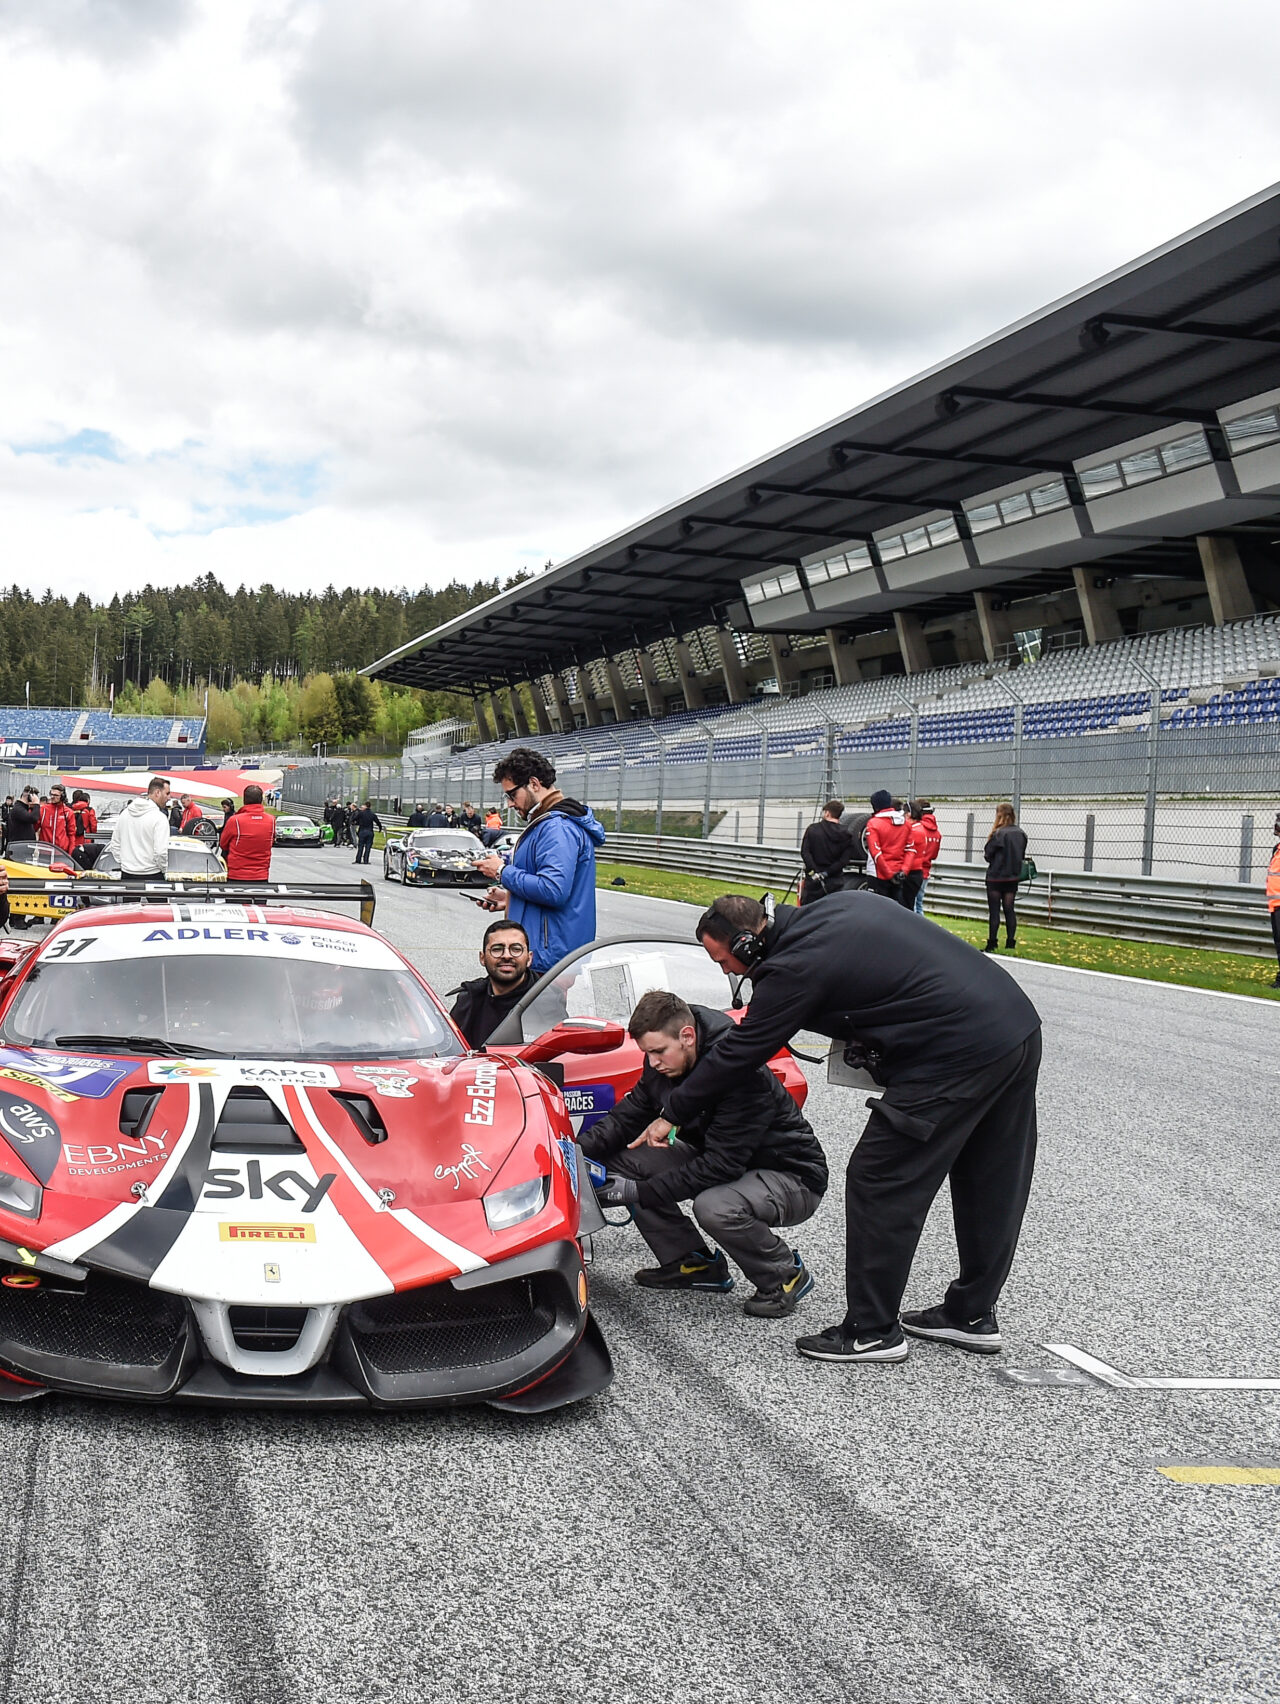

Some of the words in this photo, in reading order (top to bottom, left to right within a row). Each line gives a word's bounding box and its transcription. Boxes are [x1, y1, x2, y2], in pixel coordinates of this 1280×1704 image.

[53, 895, 74, 907] 26
[142, 928, 270, 942] ADLER
[45, 938, 99, 960] 37
[239, 1068, 327, 1079] KAPCI
[245, 1076, 327, 1085] COATINGS
[463, 1098, 496, 1126] Ezz
[566, 1096, 594, 1111] RACES
[9, 1103, 56, 1139] aws
[63, 1129, 168, 1165] EBNY
[68, 1152, 168, 1176] DEVELOPMENTS
[203, 1159, 338, 1213] sky
[228, 1225, 306, 1240] PIRELLI
